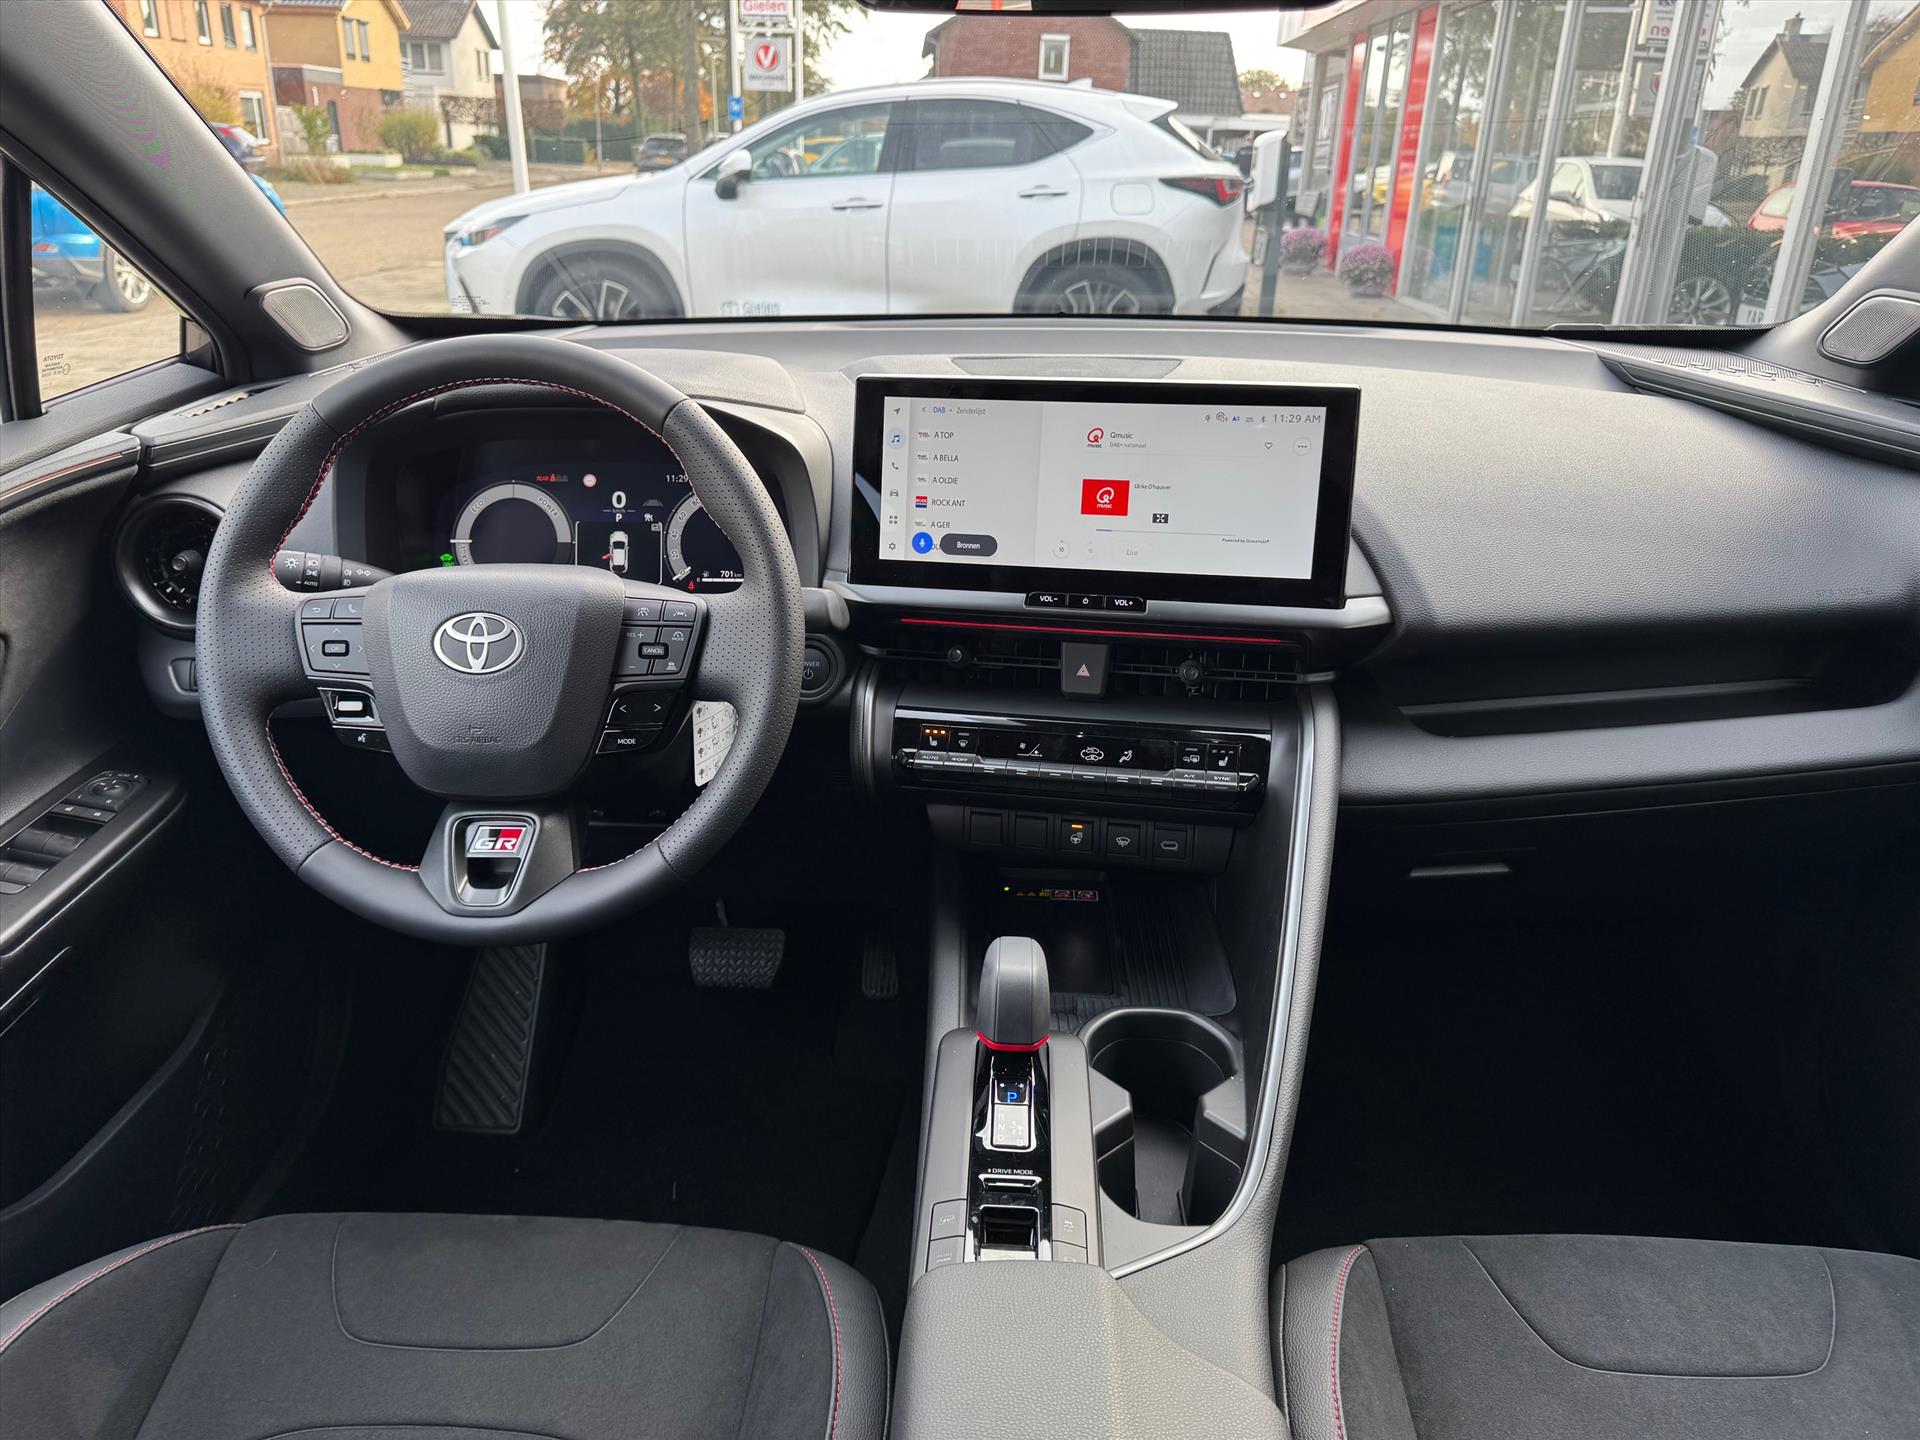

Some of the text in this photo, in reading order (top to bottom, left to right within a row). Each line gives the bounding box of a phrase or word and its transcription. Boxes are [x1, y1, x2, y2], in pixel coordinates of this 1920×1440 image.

[956, 408, 986, 416] Zenderlijst
[1274, 414, 1321, 424] 11:29 AM
[612, 491, 626, 508] 0
[472, 500, 484, 513] ECO
[538, 497, 559, 518] POWER
[616, 514, 622, 522] P
[678, 511, 687, 521] 60
[672, 530, 678, 540] 40
[956, 542, 980, 550] Bronnen
[672, 550, 679, 559] 20
[475, 838, 517, 850] GR
[1008, 1092, 1017, 1103] P
